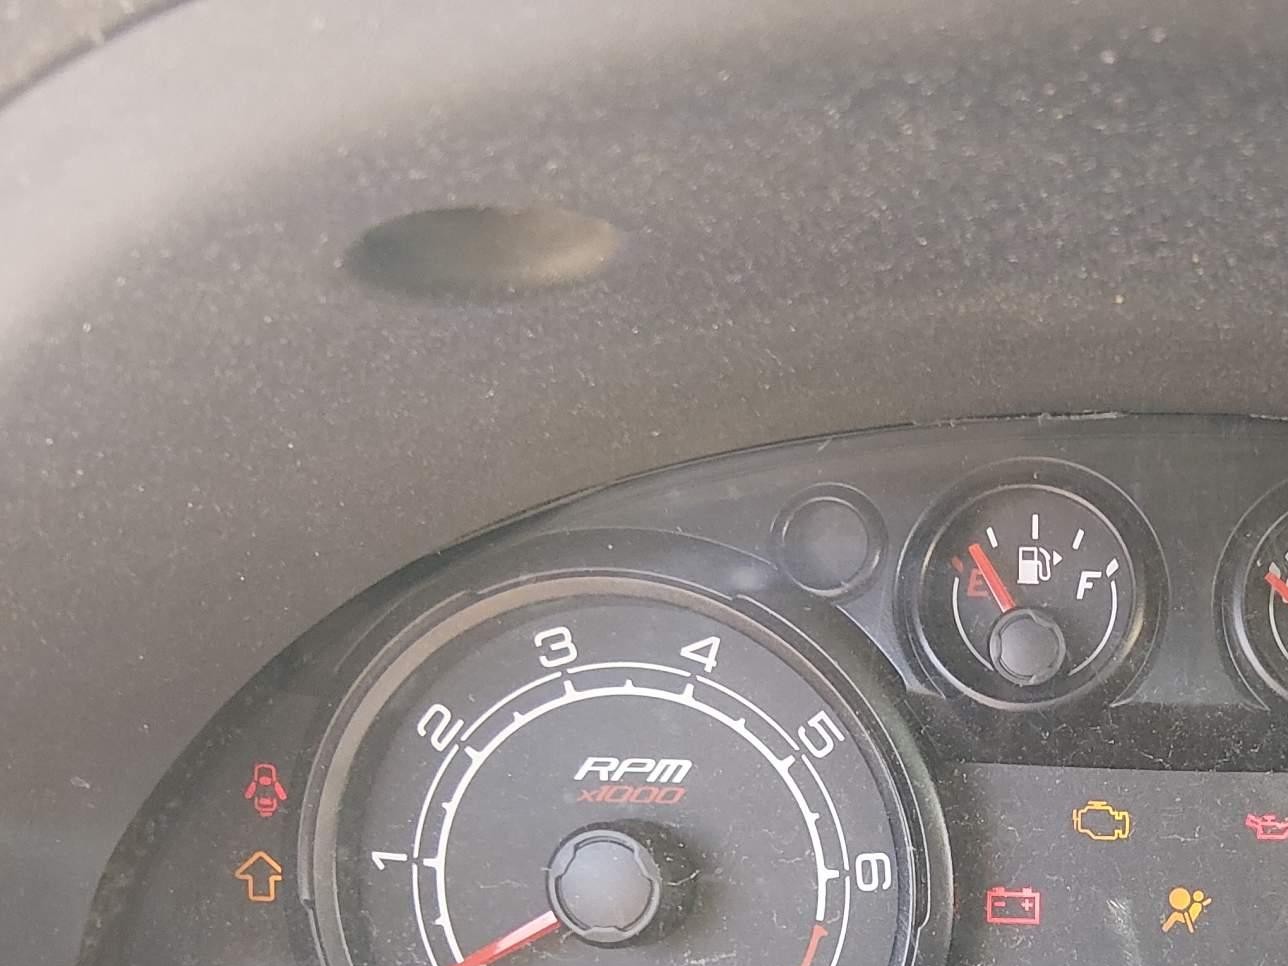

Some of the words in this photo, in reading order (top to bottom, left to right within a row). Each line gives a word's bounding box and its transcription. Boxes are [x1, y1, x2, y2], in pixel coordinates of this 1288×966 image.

[966, 567, 991, 597] E
[1076, 570, 1102, 600] F
[533, 626, 579, 669] 3
[680, 636, 723, 673] 4
[417, 703, 465, 749] 2
[797, 709, 846, 760] 5
[573, 756, 694, 784] RPM
[577, 784, 688, 805] x1000
[371, 850, 409, 871] 1
[855, 851, 892, 892] 6
